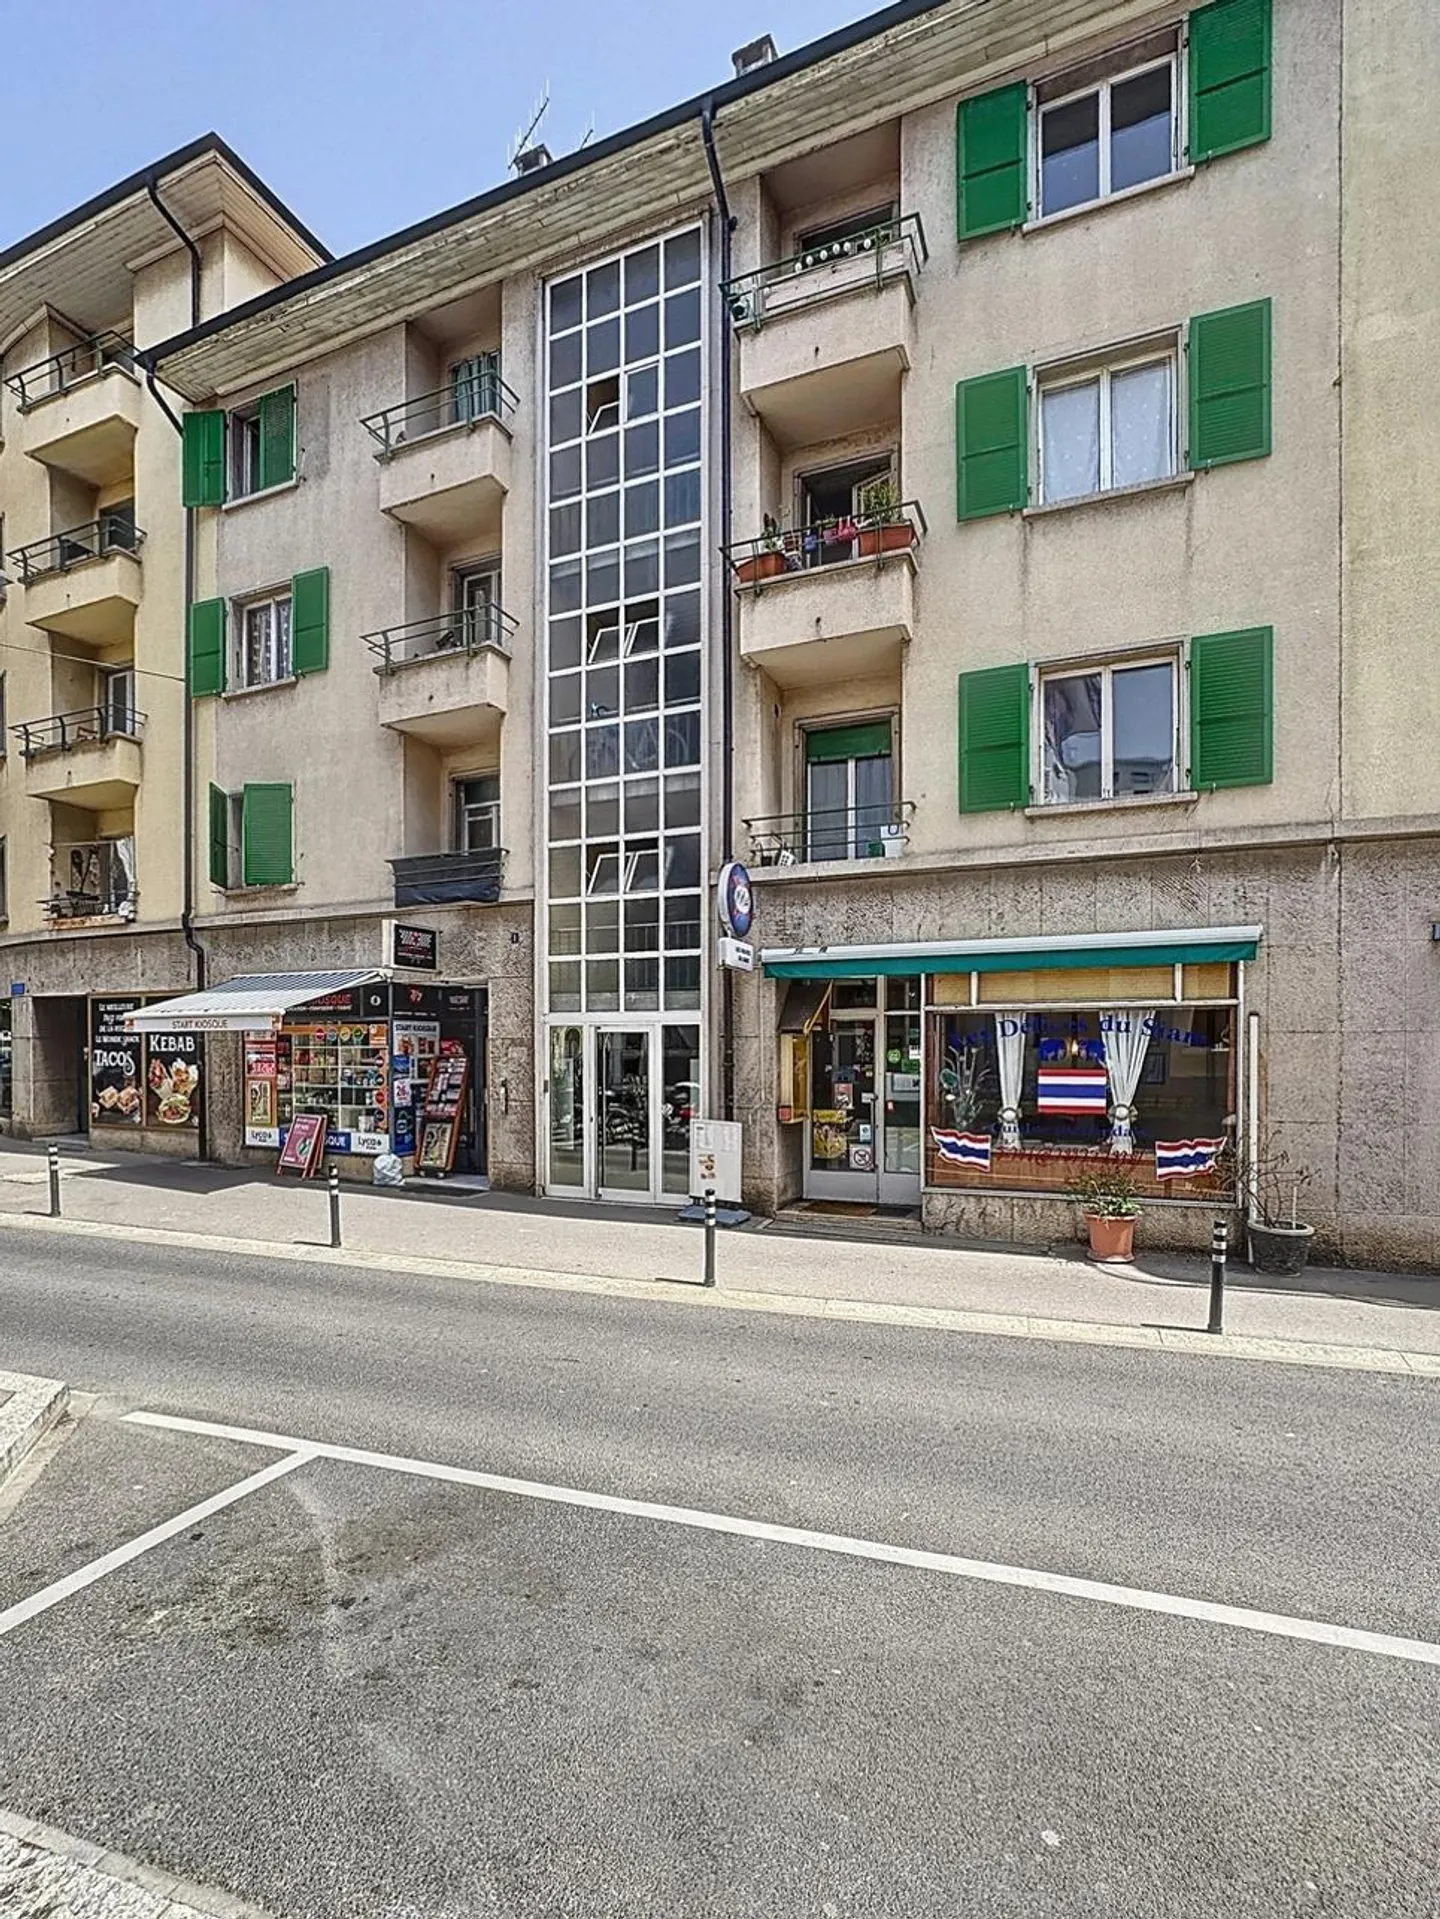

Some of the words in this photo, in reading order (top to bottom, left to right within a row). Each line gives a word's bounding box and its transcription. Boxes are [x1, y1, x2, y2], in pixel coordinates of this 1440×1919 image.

[171, 1019, 193, 1029] START
[1100, 1015, 1132, 1034] du
[149, 1034, 195, 1052] KEBAB
[93, 1049, 136, 1076] TACOS
[358, 1136, 377, 1148] Lyco
